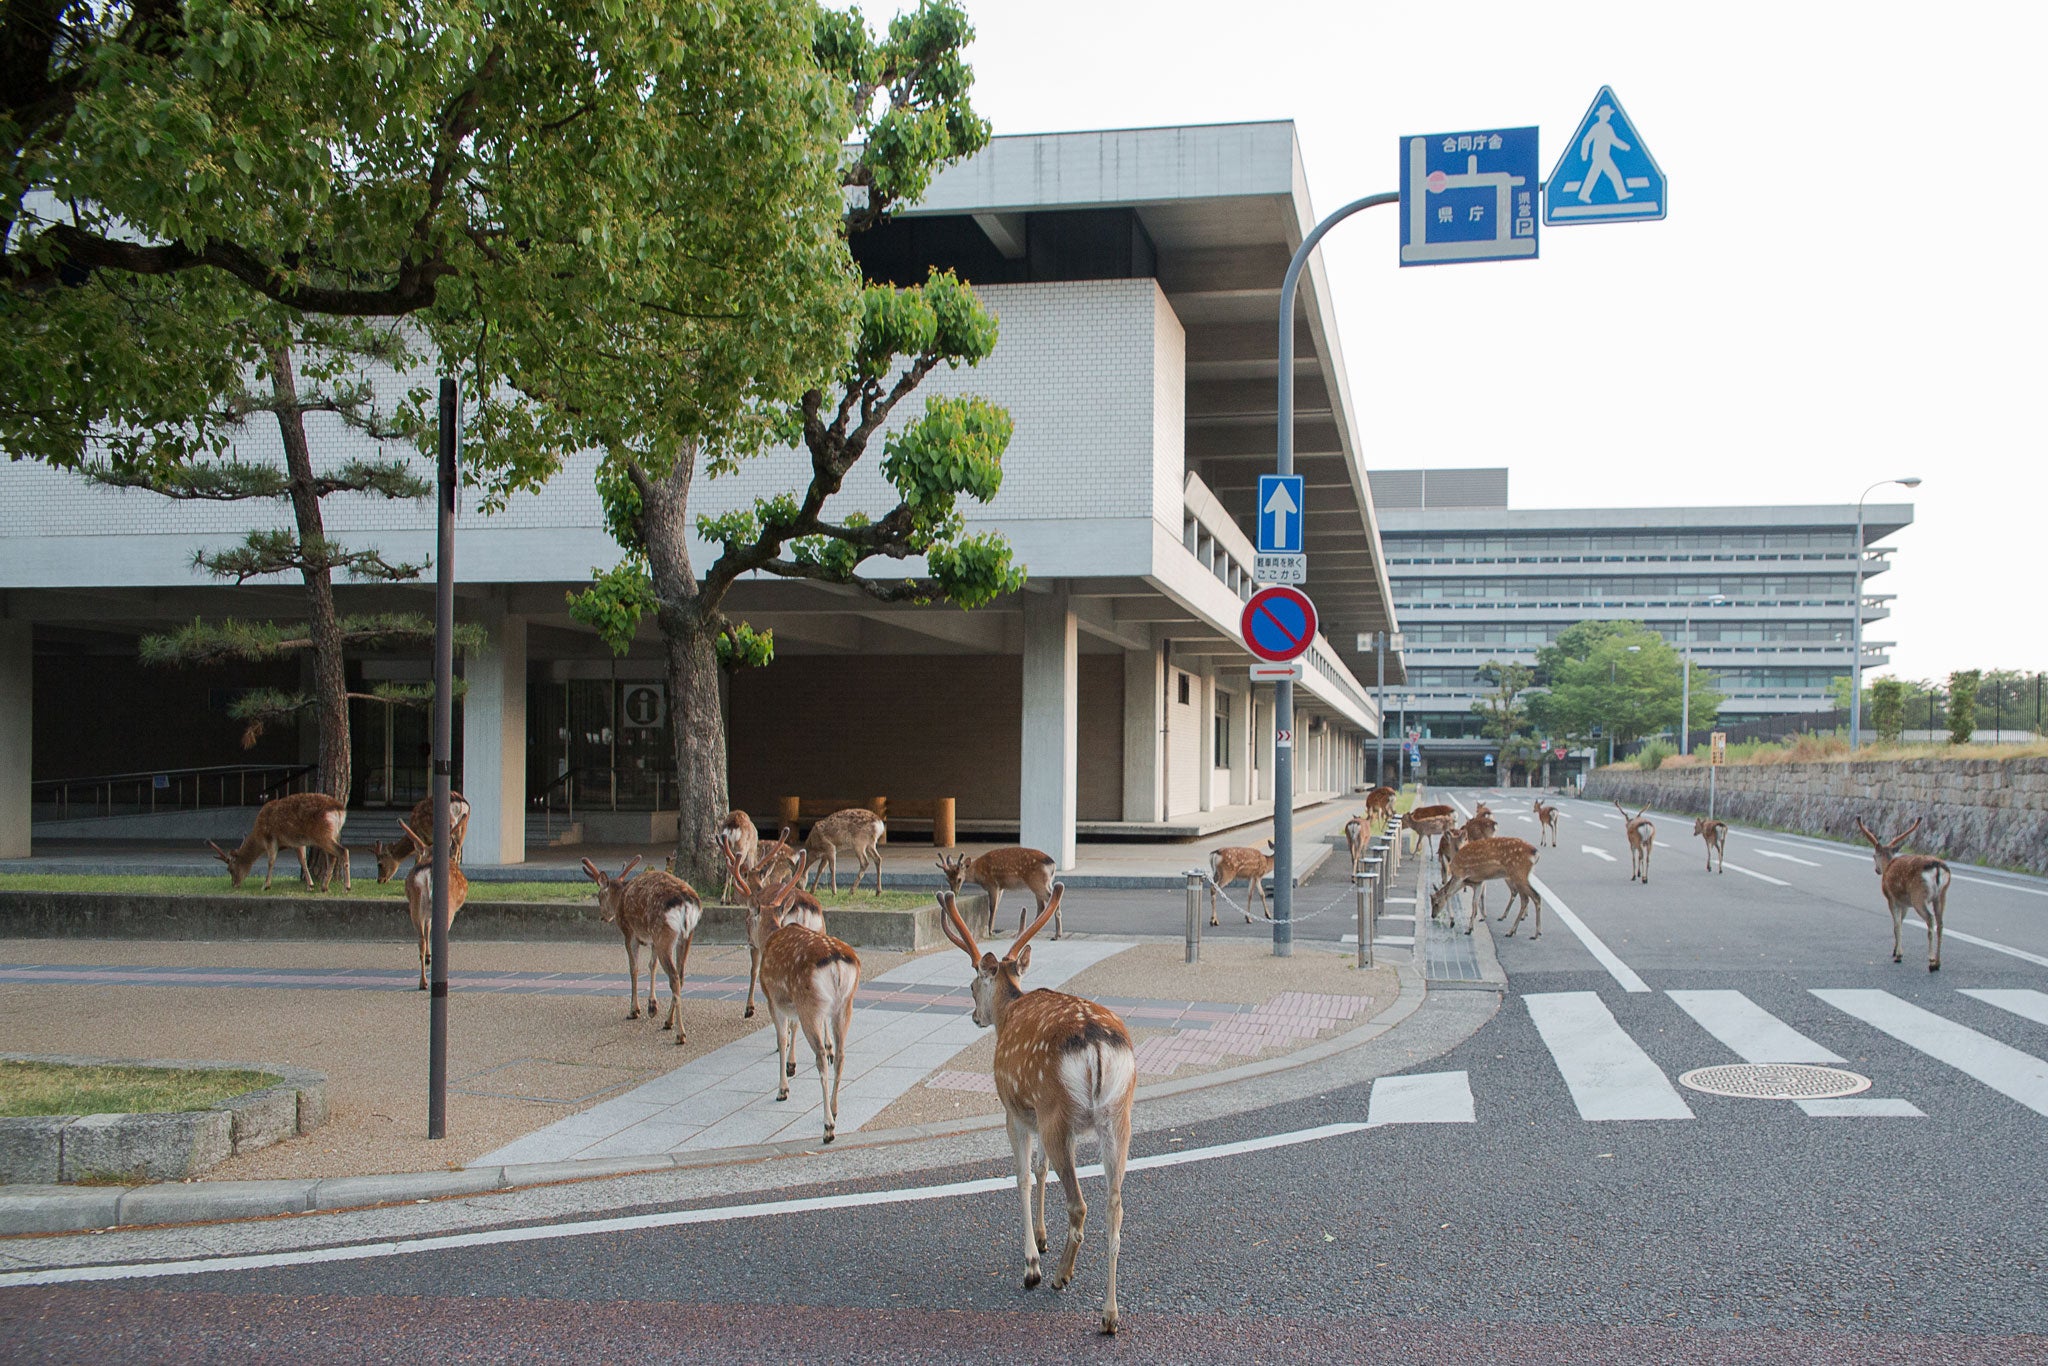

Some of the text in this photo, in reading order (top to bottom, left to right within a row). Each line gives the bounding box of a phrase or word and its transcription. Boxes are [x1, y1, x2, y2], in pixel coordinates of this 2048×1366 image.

[1442, 134, 1502, 152] 合同庁舎
[1257, 558, 1301, 568] 軽車両を除く
[1258, 570, 1301, 580] ここから
